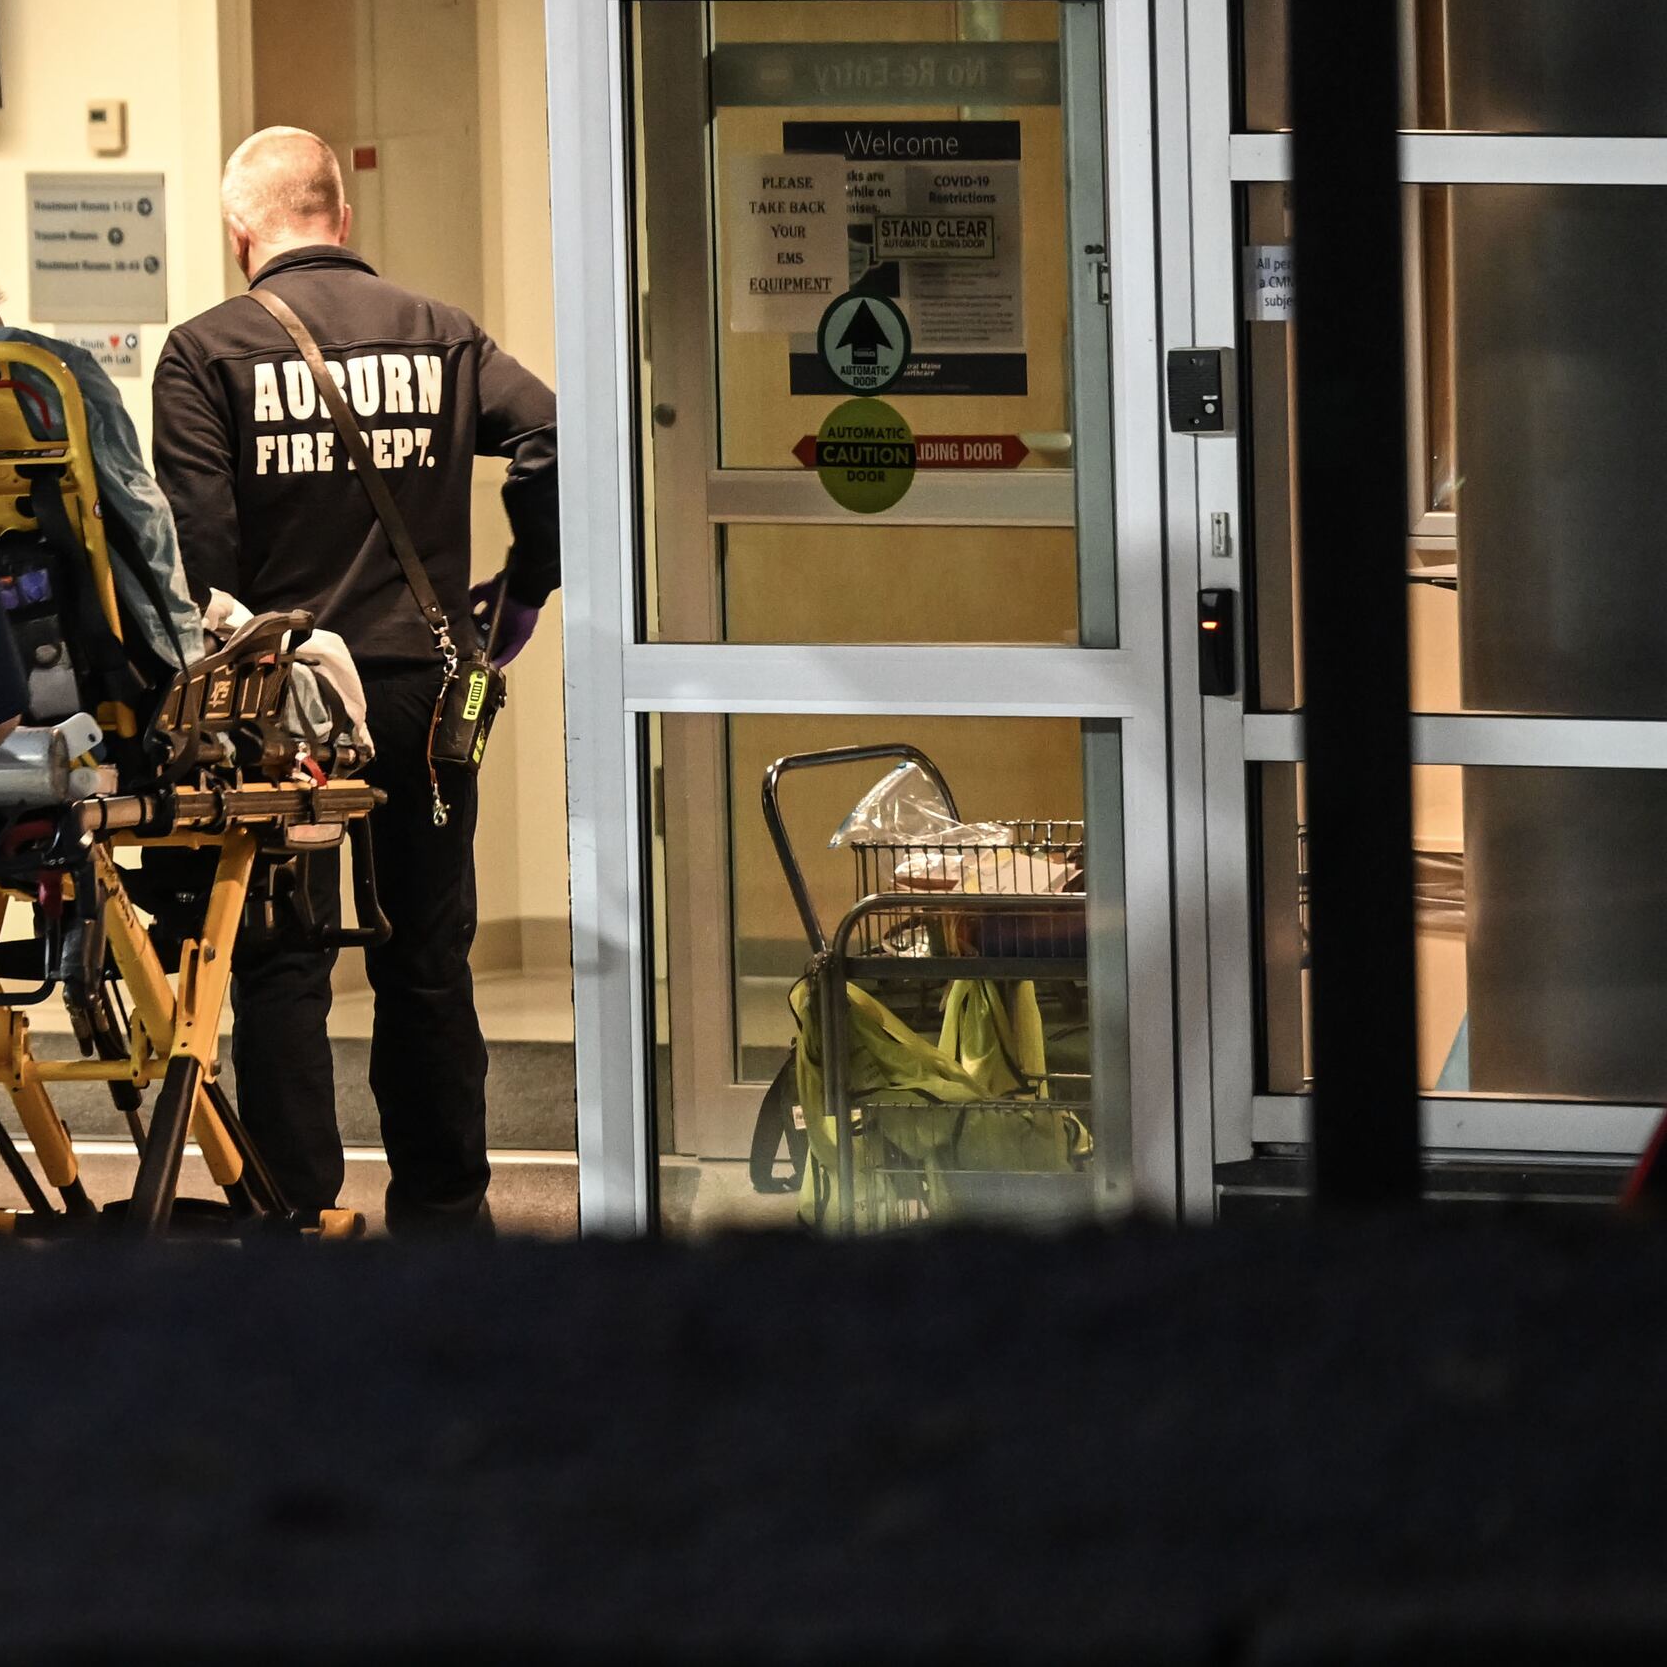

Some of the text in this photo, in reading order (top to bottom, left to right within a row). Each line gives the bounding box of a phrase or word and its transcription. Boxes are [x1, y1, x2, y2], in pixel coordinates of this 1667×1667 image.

[845, 129, 959, 155] Welcome
[762, 177, 813, 189] PLEASE
[934, 175, 990, 188] COVID-19
[877, 189, 891, 198] on
[929, 191, 996, 204] Restrictions
[749, 201, 826, 214] TAKE BACK
[770, 224, 806, 238] YOUR
[881, 220, 988, 237] STAND CLEAR
[883, 240, 928, 249] AUTOMATIC
[962, 240, 985, 249] DOOR
[777, 252, 804, 265] EMS
[1257, 258, 1271, 270] All
[748, 277, 833, 295] EQUIPMENT
[1259, 278, 1266, 289] a
[840, 365, 890, 376] AUTOMATIC
[853, 376, 878, 386] DOOR
[254, 354, 443, 422] AUBURN
[827, 427, 906, 441] AUTOMATIC
[256, 432, 335, 475] FIRE
[822, 445, 910, 465] CAUTION
[963, 443, 1003, 461] DOOR
[847, 470, 886, 483] DOOR
